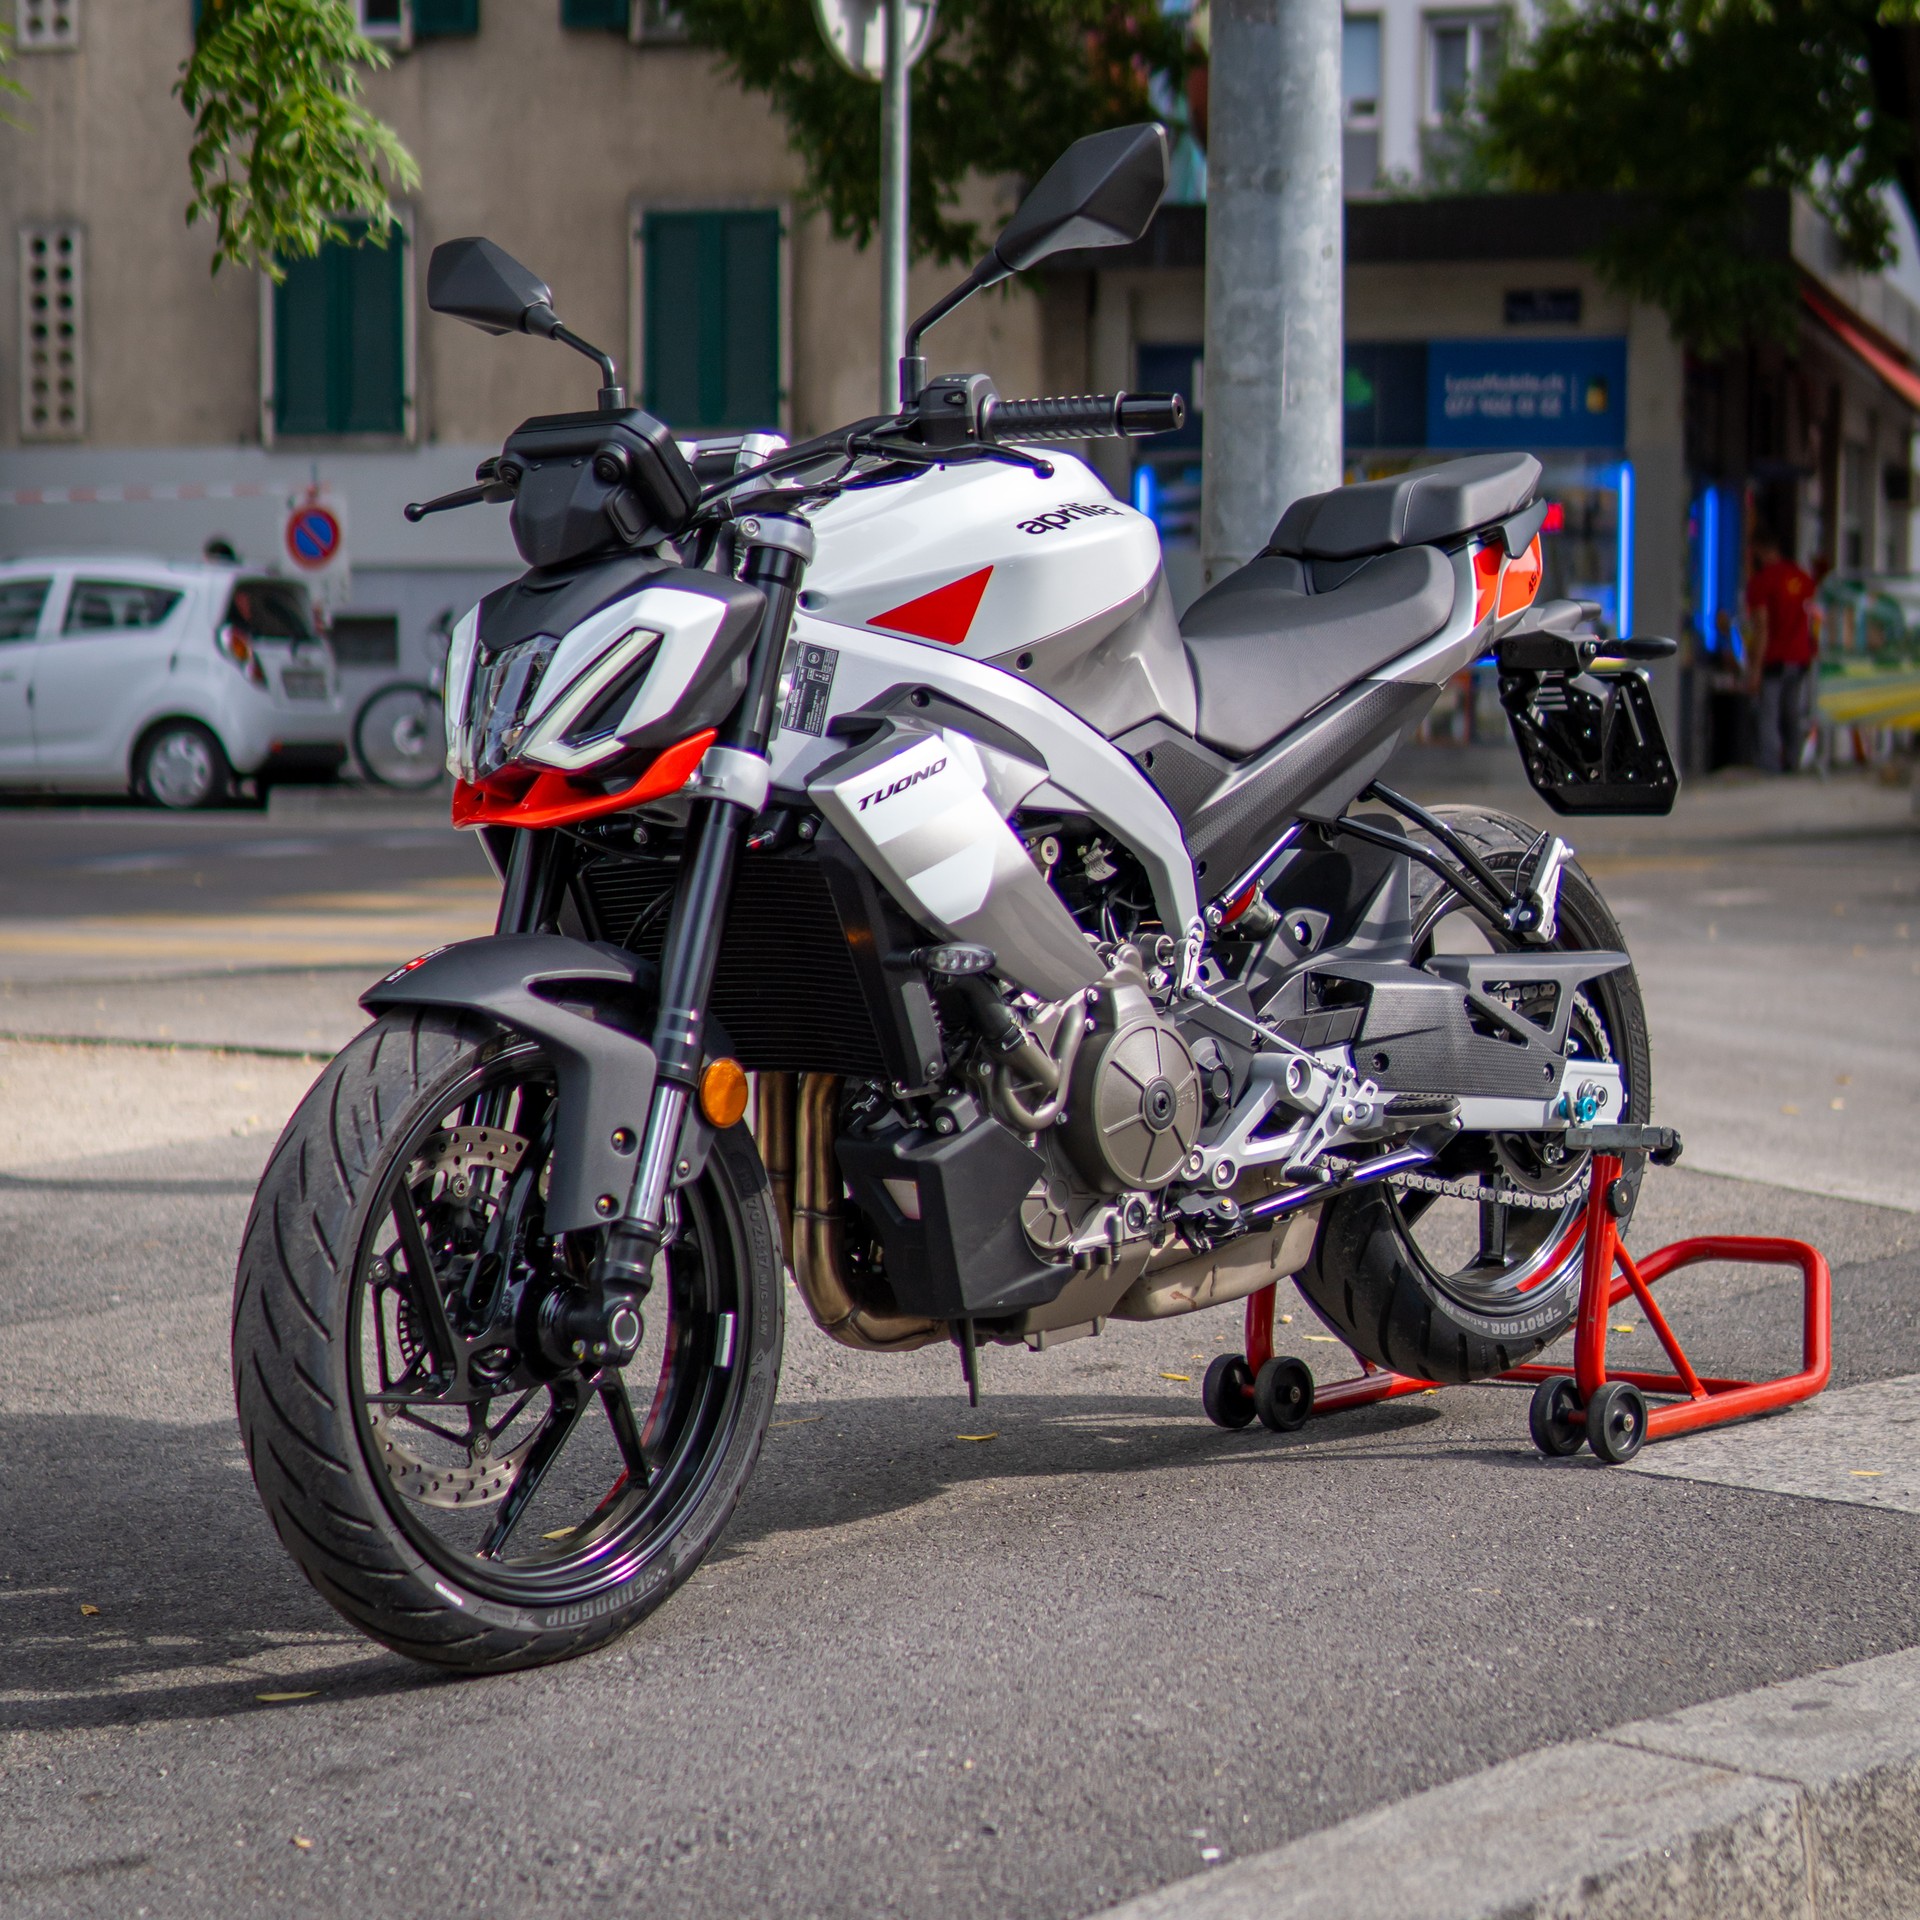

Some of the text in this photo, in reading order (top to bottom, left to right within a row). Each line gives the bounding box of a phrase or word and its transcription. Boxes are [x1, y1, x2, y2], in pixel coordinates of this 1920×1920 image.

[1016, 502, 1125, 535] aprilia
[857, 757, 947, 812] TUONO
[1630, 1031, 1649, 1124] EUROGR
[1490, 1307, 1554, 1335] PROTORQ
[546, 1578, 647, 1627] EUROGRIP
